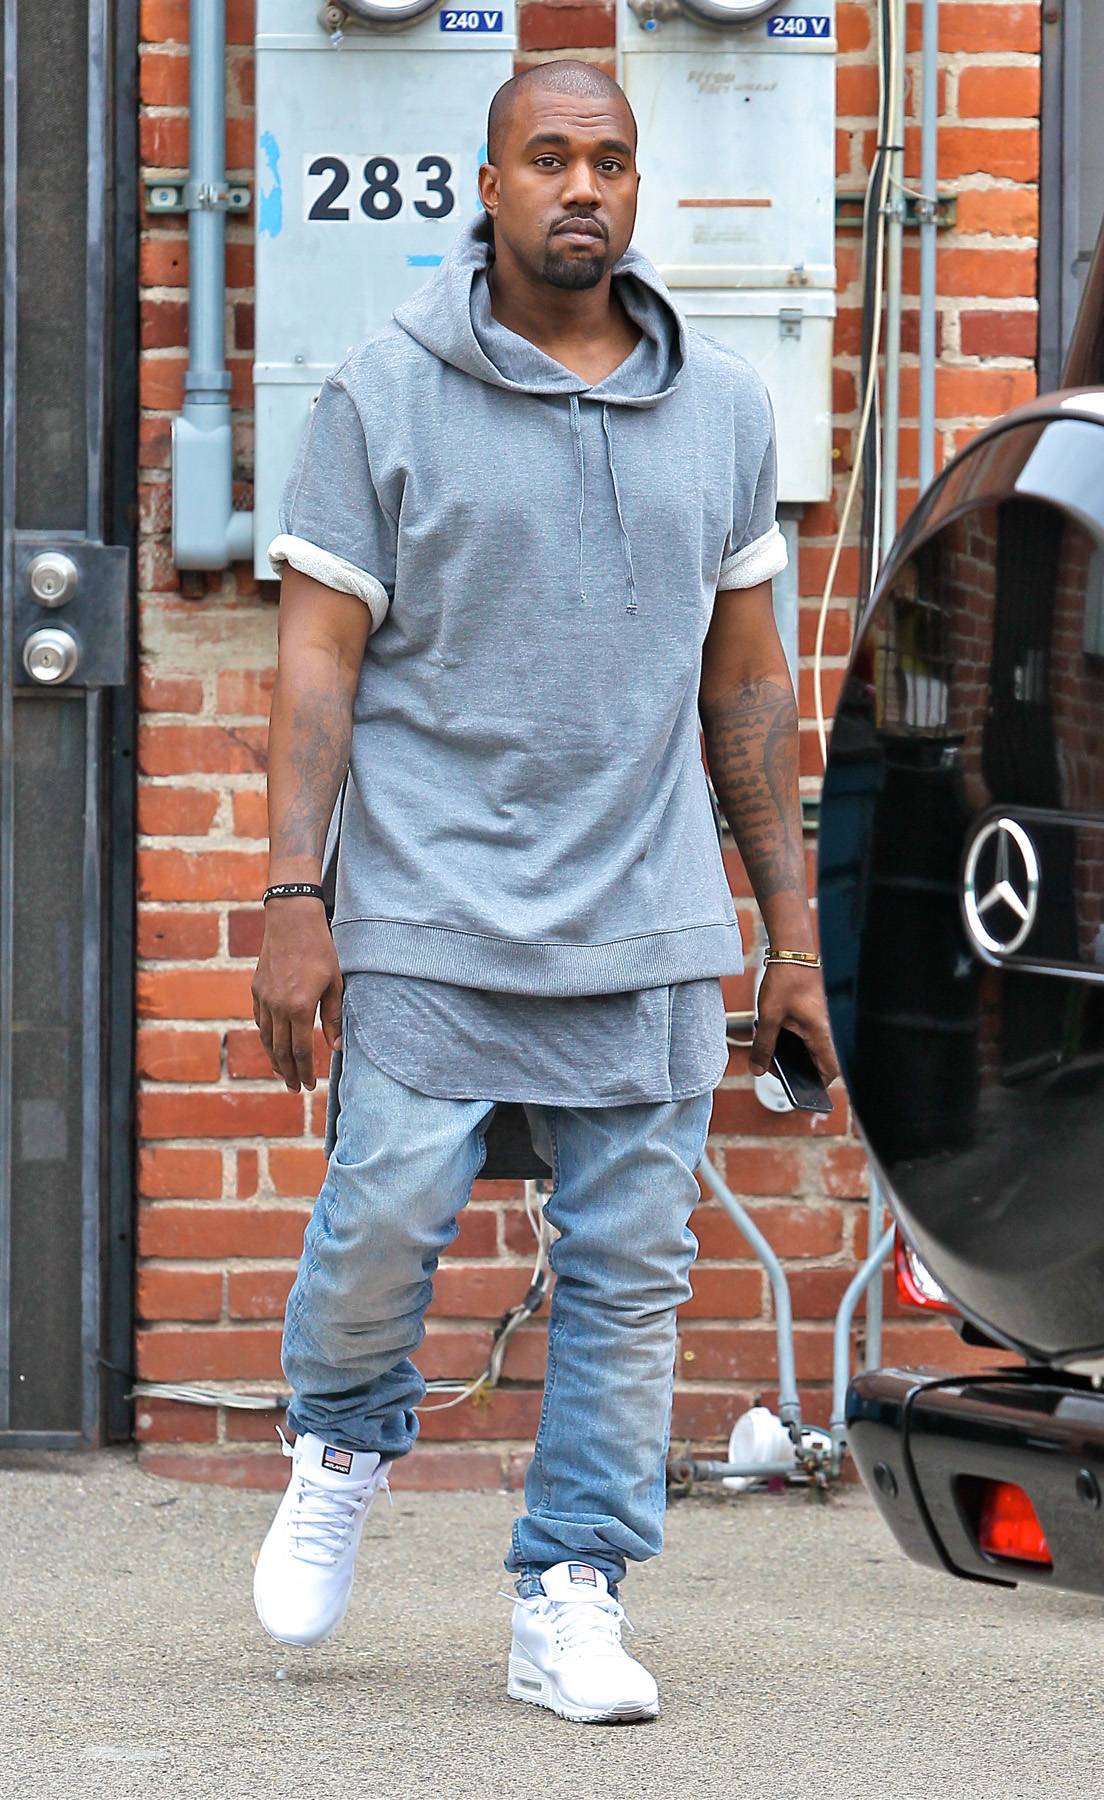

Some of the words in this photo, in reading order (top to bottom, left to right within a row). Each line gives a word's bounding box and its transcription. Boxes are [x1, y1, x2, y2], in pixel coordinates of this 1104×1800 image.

[445, 12, 479, 29] 240
[483, 12, 499, 29] V
[773, 17, 807, 34] 240
[810, 18, 826, 34] V
[307, 155, 455, 221] 283
